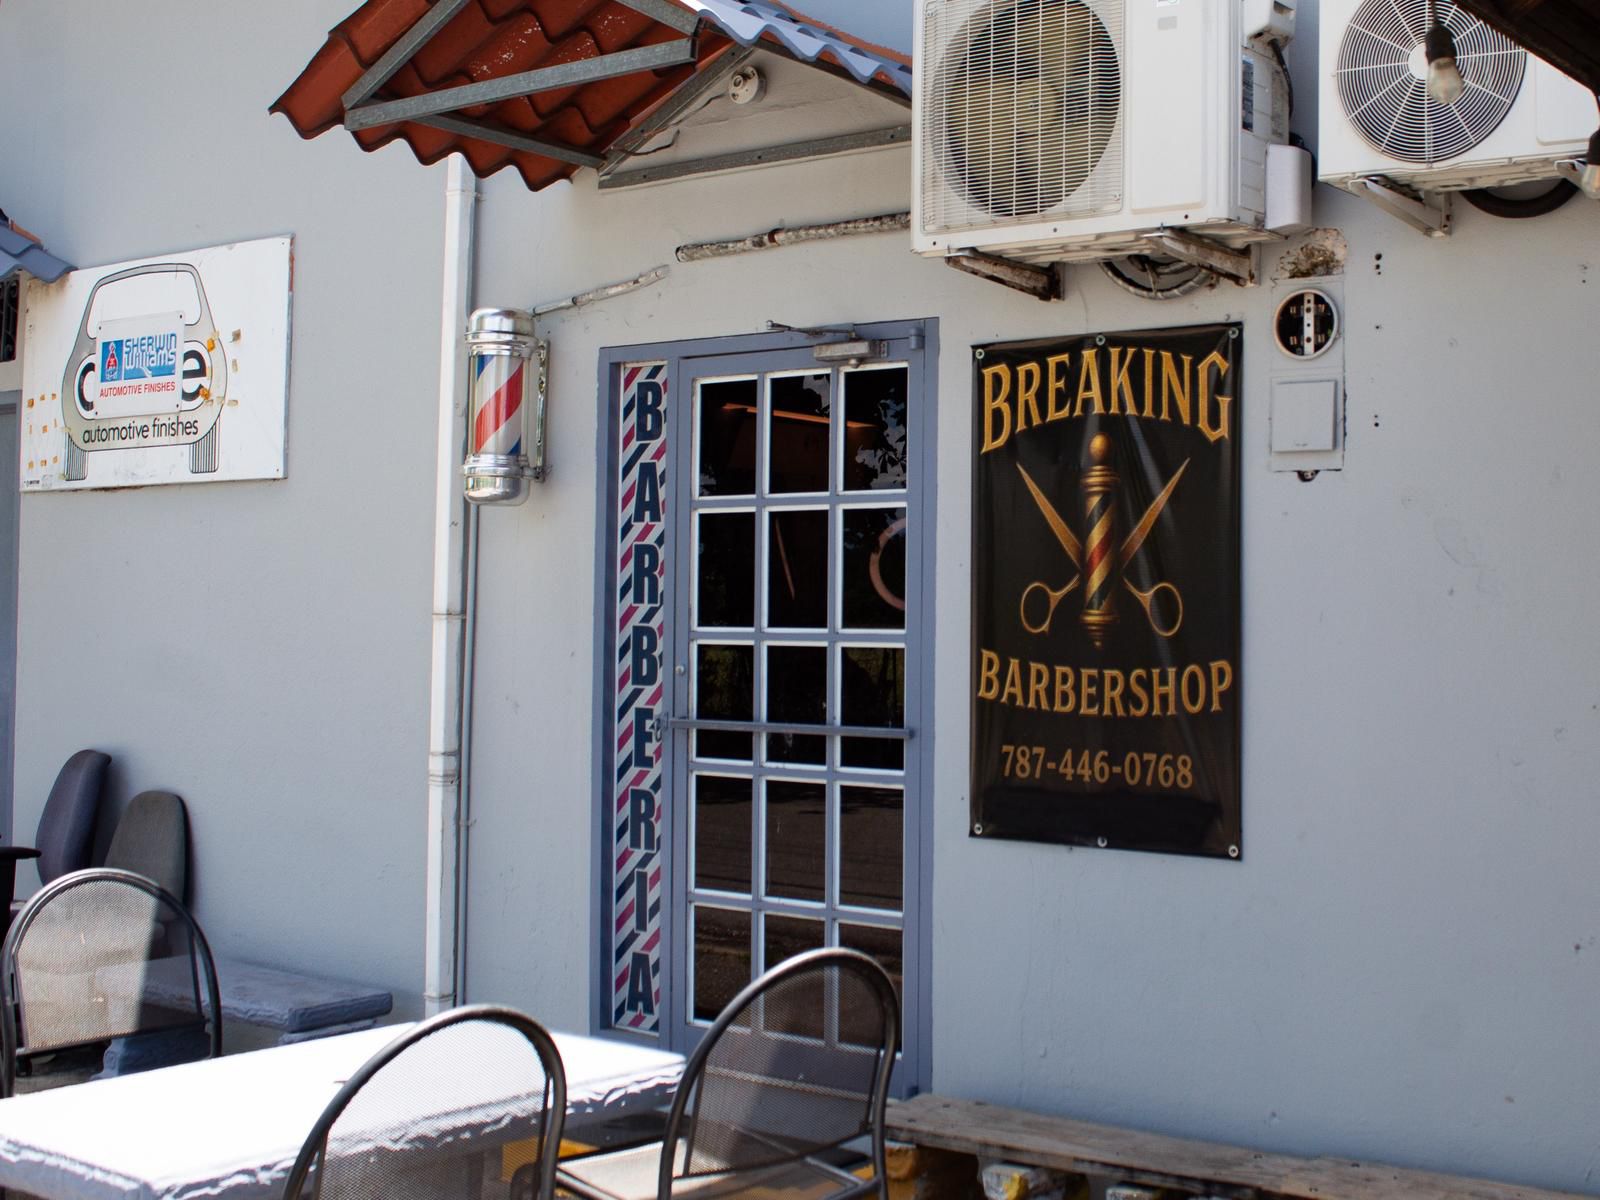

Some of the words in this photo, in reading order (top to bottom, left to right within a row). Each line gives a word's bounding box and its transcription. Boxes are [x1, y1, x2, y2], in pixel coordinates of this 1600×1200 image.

[124, 334, 177, 354] SHERWIN
[99, 384, 143, 398] AUTOMOTIVE
[143, 381, 176, 394] FINISHES
[979, 345, 1233, 456] BREAKING
[82, 420, 149, 443] automotive
[151, 415, 199, 438] finishes
[626, 380, 664, 1017] BARBERIA
[977, 648, 1233, 718] BARBERSHOP
[1001, 744, 1194, 789] 787-446-0768
